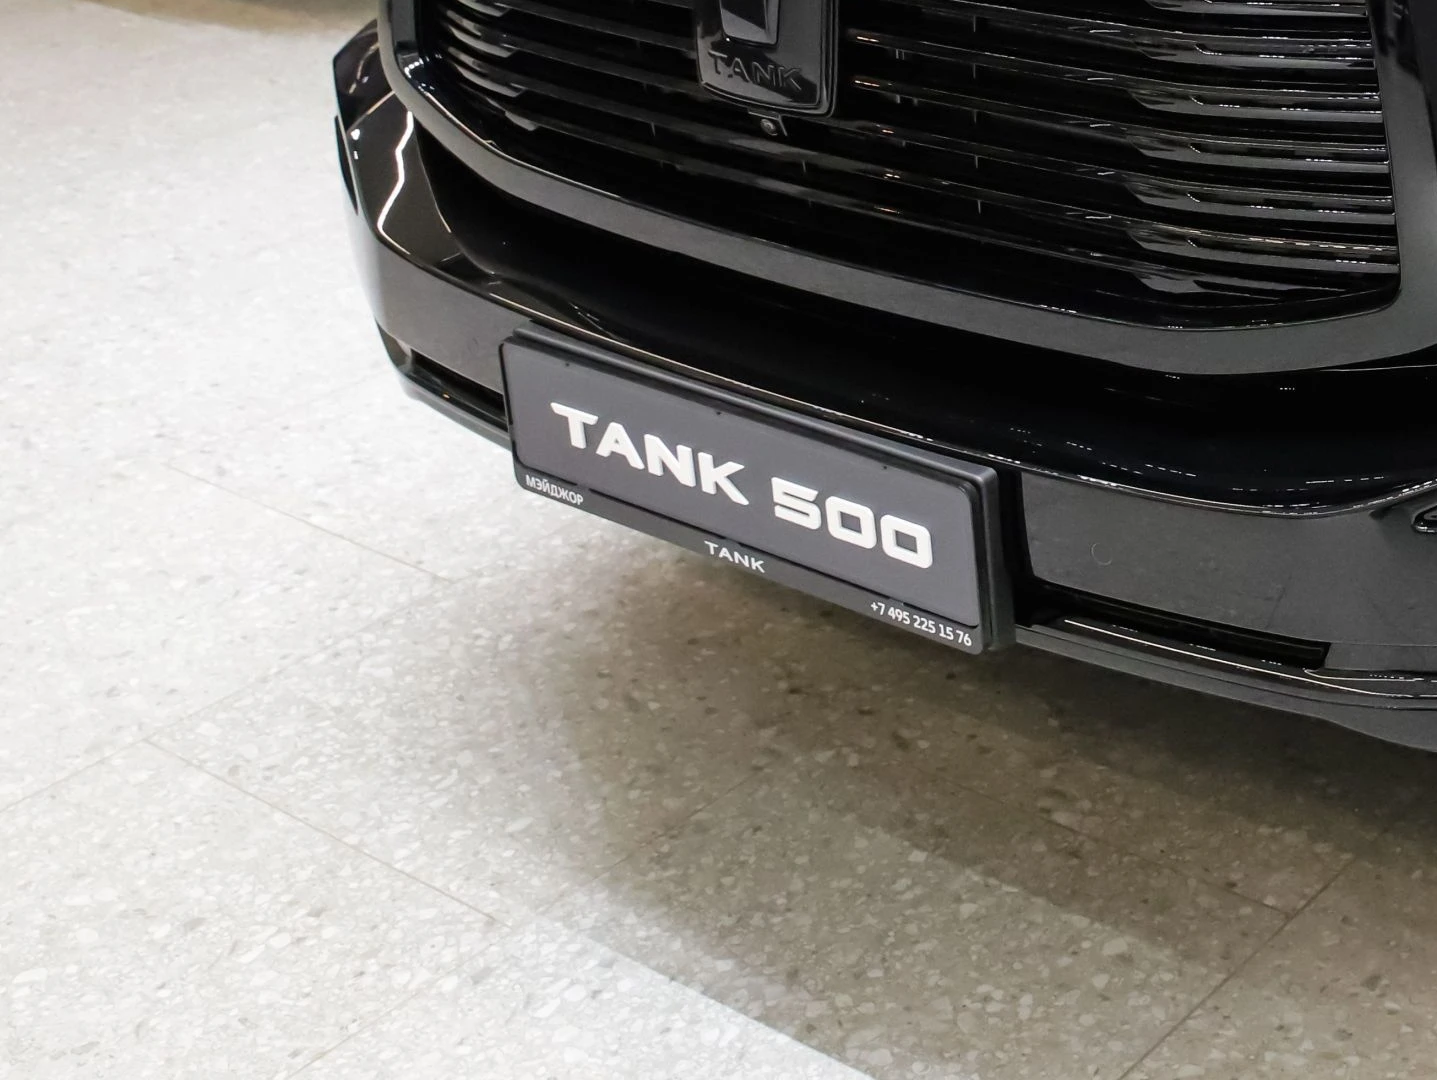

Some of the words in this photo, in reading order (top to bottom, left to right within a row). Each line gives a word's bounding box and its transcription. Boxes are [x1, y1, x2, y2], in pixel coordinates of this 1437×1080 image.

[707, 49, 802, 91] TANK
[525, 474, 584, 506] МЭЙДЖОР
[550, 402, 749, 506] TANK
[771, 476, 933, 569] 500
[704, 540, 766, 574] TANK
[870, 602, 886, 616] +7
[887, 607, 911, 625] 495
[913, 615, 936, 634] 225
[938, 624, 954, 640] 15
[956, 630, 972, 647] 76
